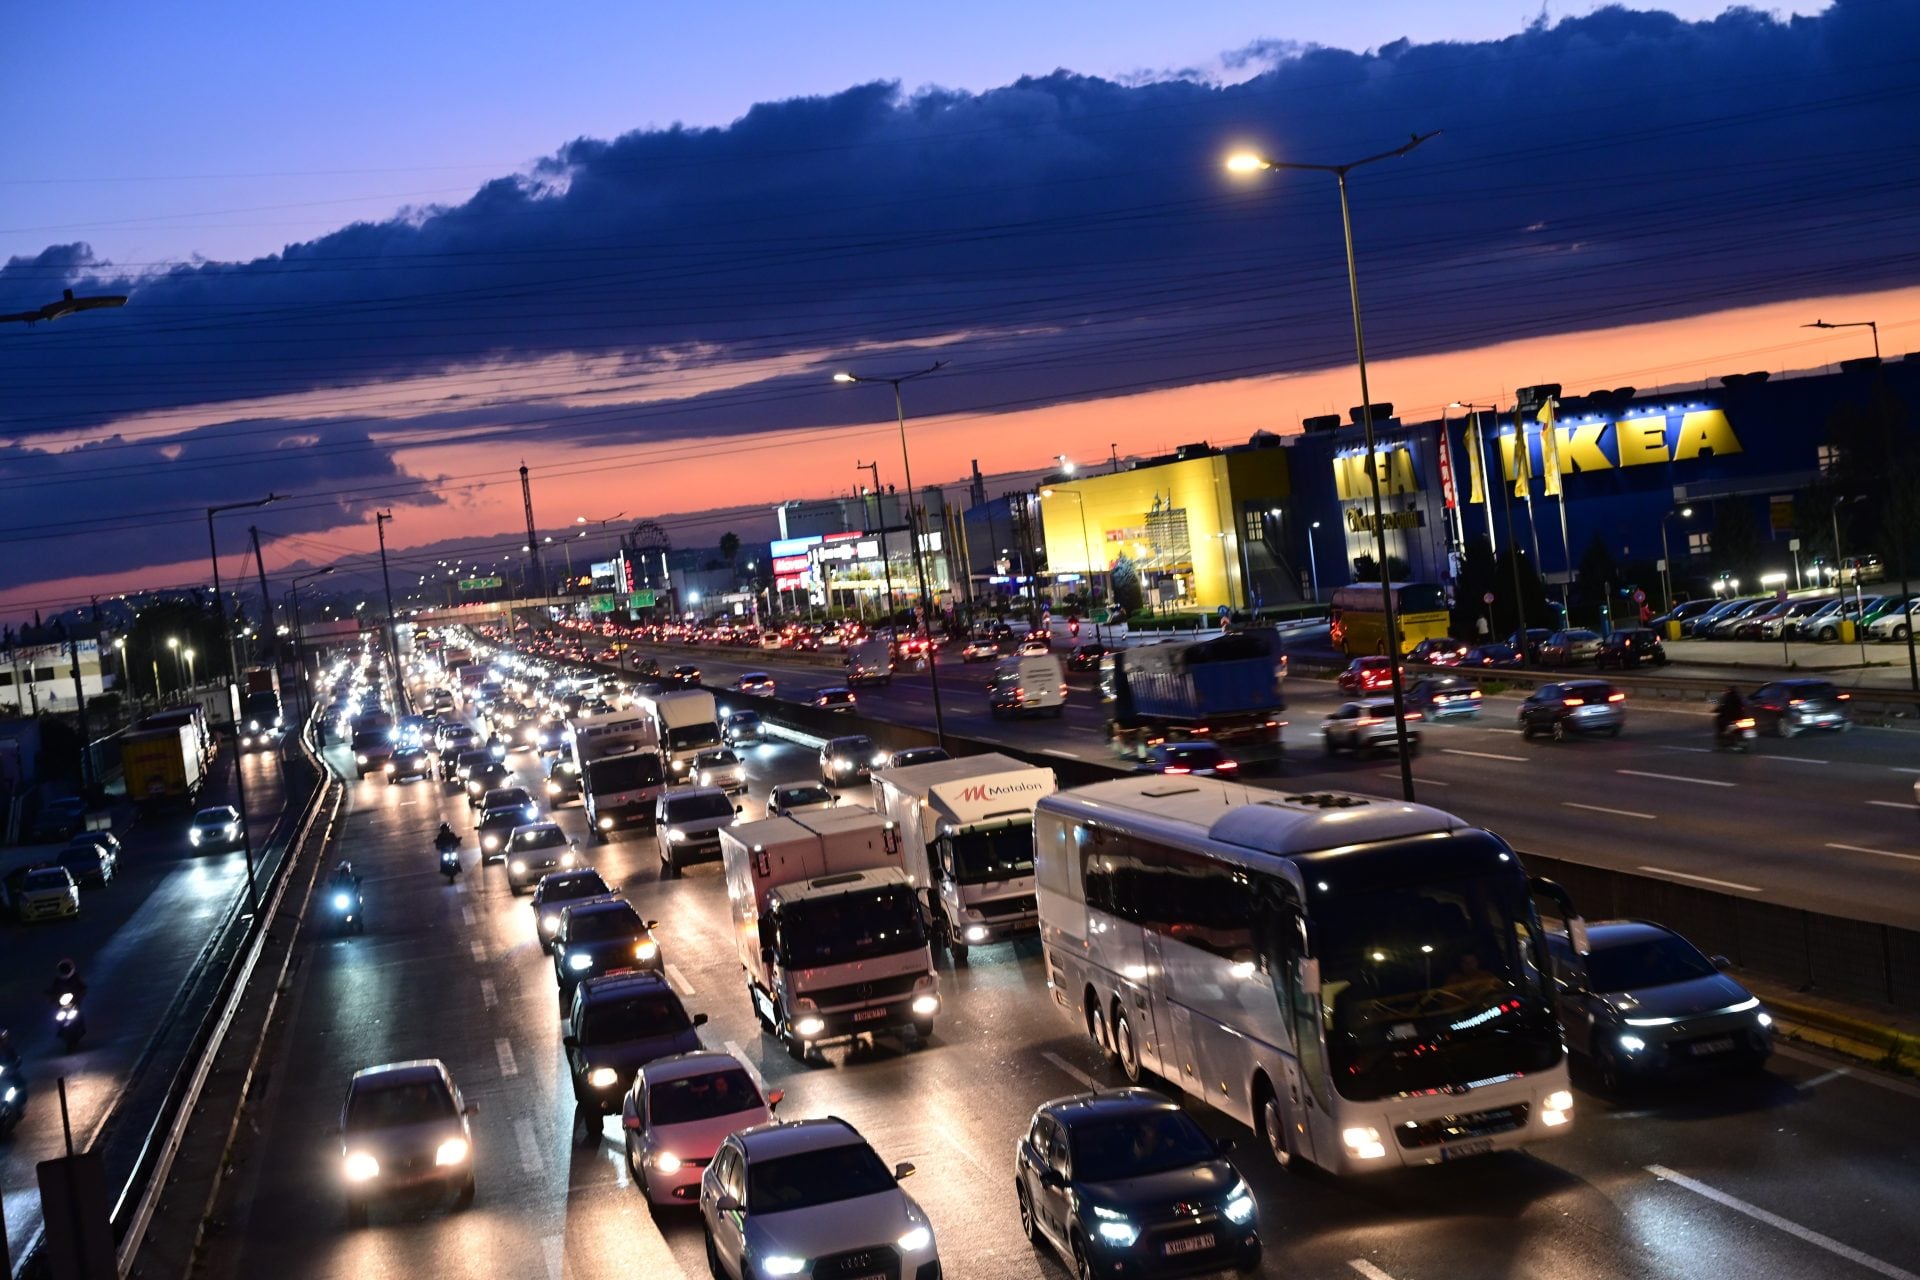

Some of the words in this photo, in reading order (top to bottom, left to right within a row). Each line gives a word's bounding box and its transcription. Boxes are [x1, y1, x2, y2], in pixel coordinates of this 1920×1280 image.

[1500, 409, 1743, 481] IKEA
[1333, 448, 1416, 501] IKEA
[989, 782, 1042, 796] Matalon
